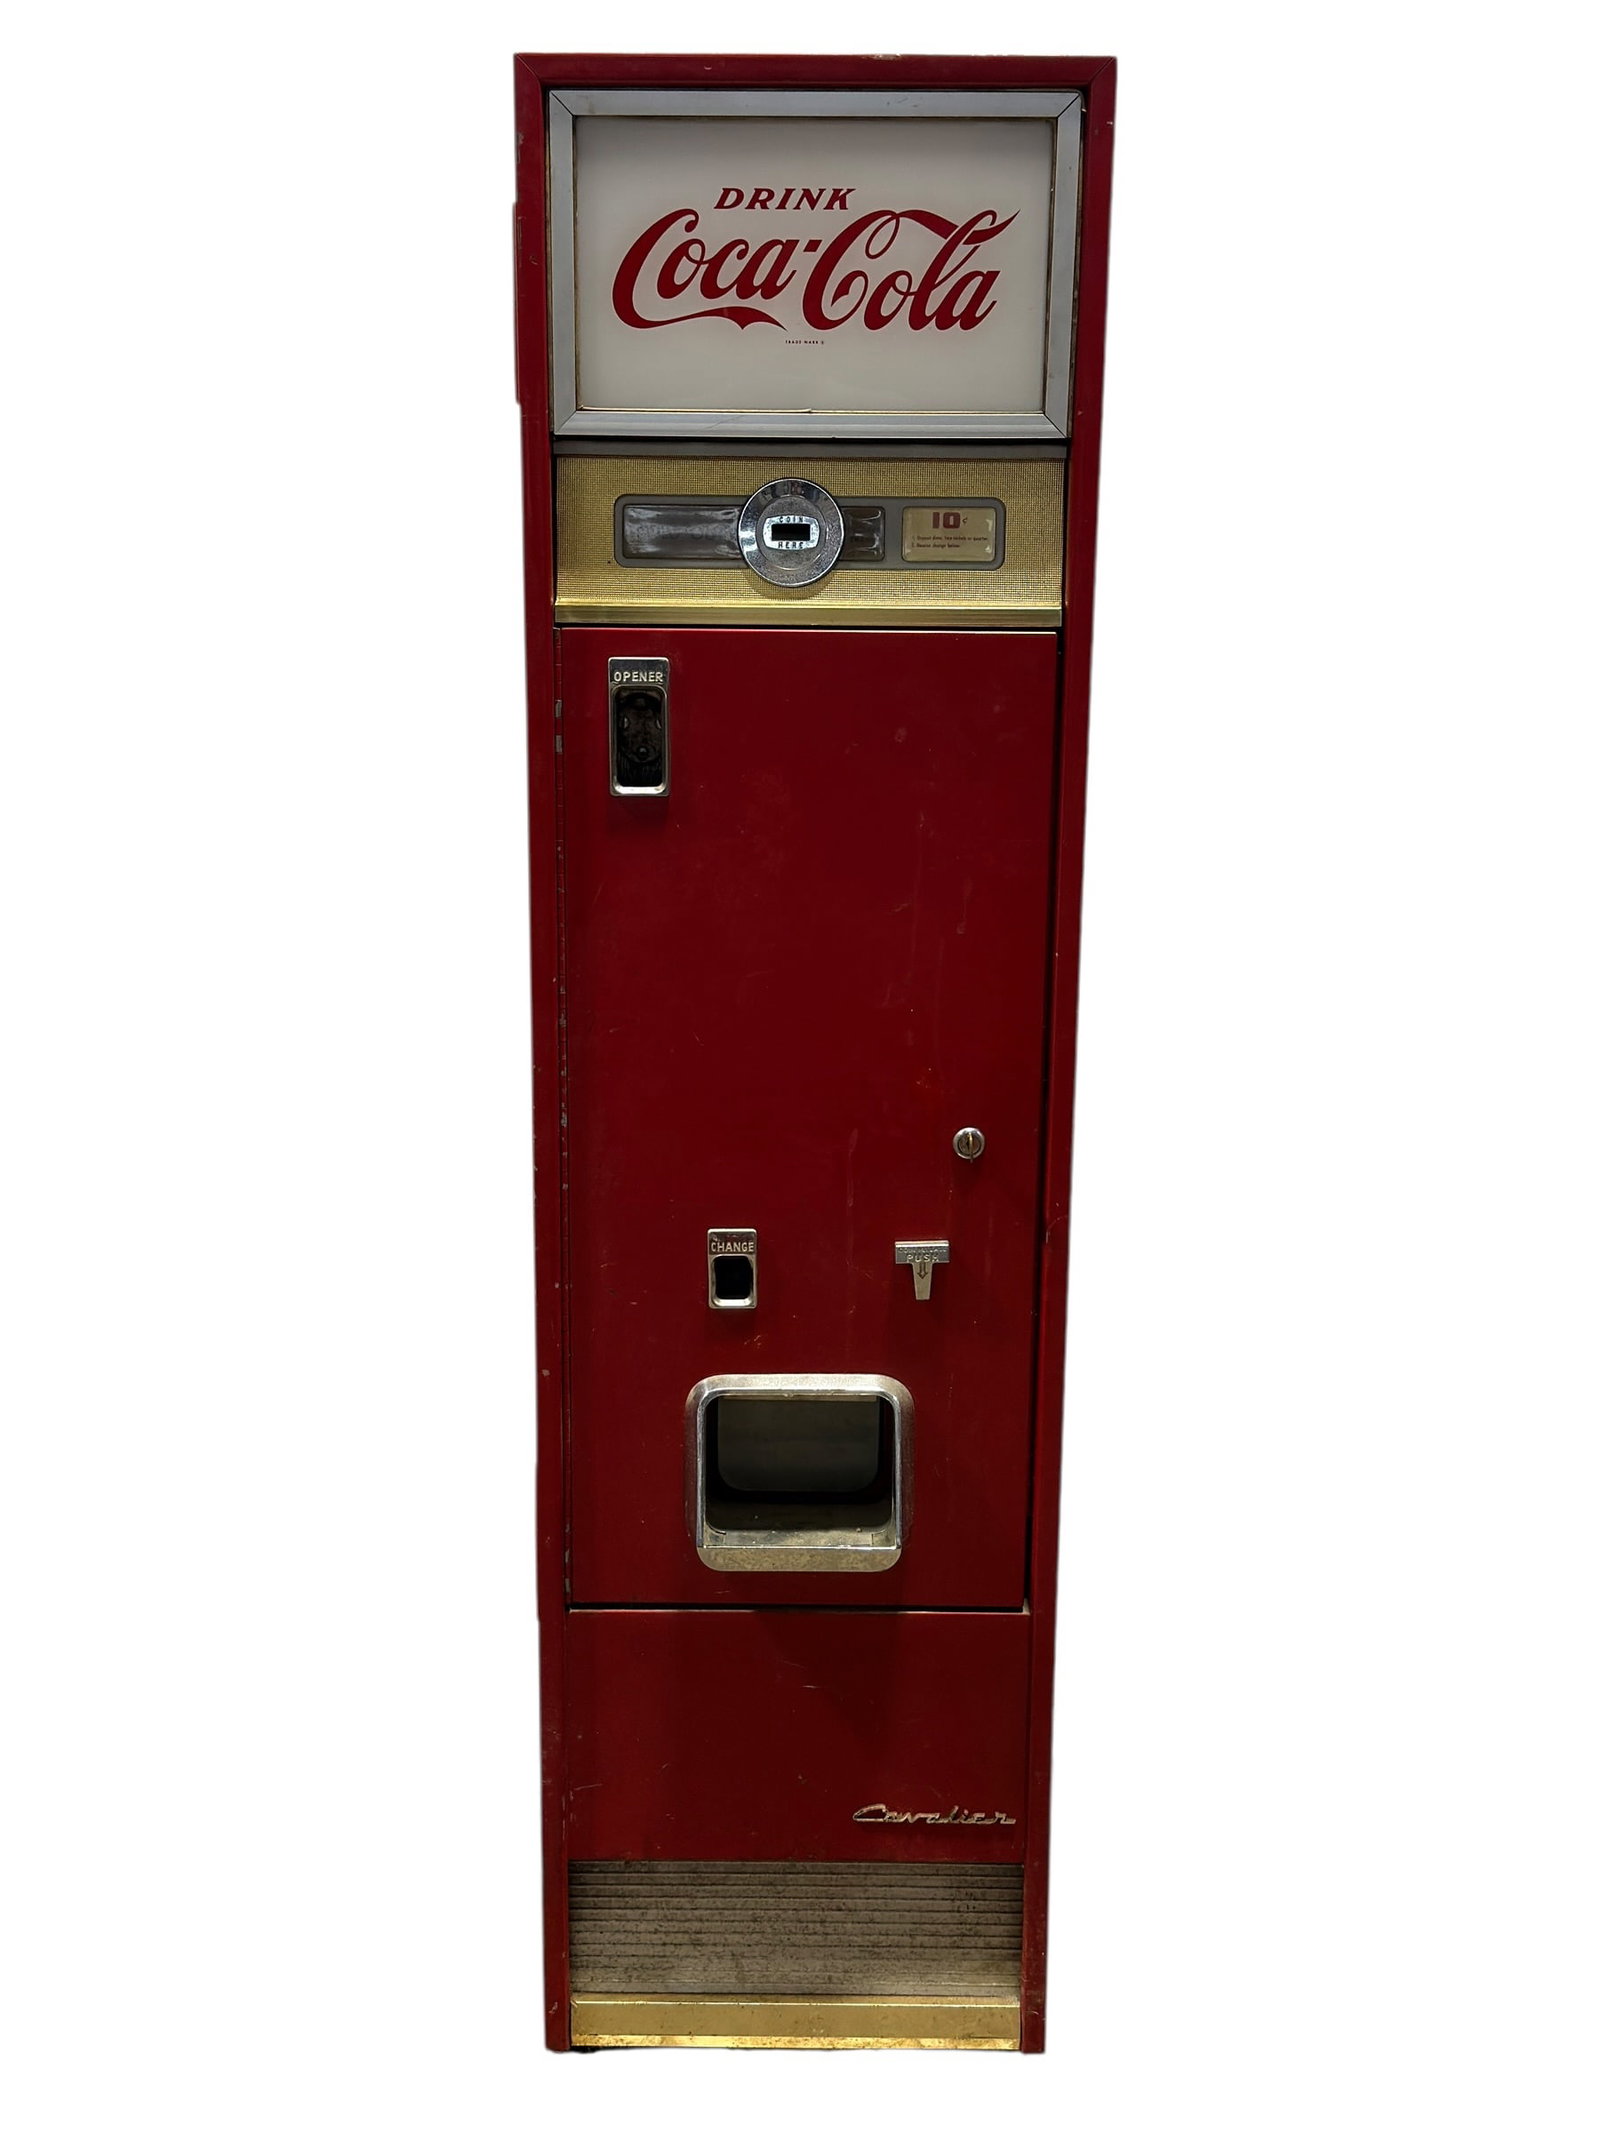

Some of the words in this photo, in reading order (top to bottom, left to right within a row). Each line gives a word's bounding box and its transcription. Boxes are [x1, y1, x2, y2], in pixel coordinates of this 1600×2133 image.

[714, 188, 856, 211] DRINK
[612, 209, 1020, 331] Coca-Cola
[778, 541, 804, 549] HERE
[613, 671, 664, 683] OPENER
[710, 1241, 755, 1252] CHANGE
[906, 1253, 940, 1263] PUSH
[852, 1803, 1017, 1825] Cavalier
